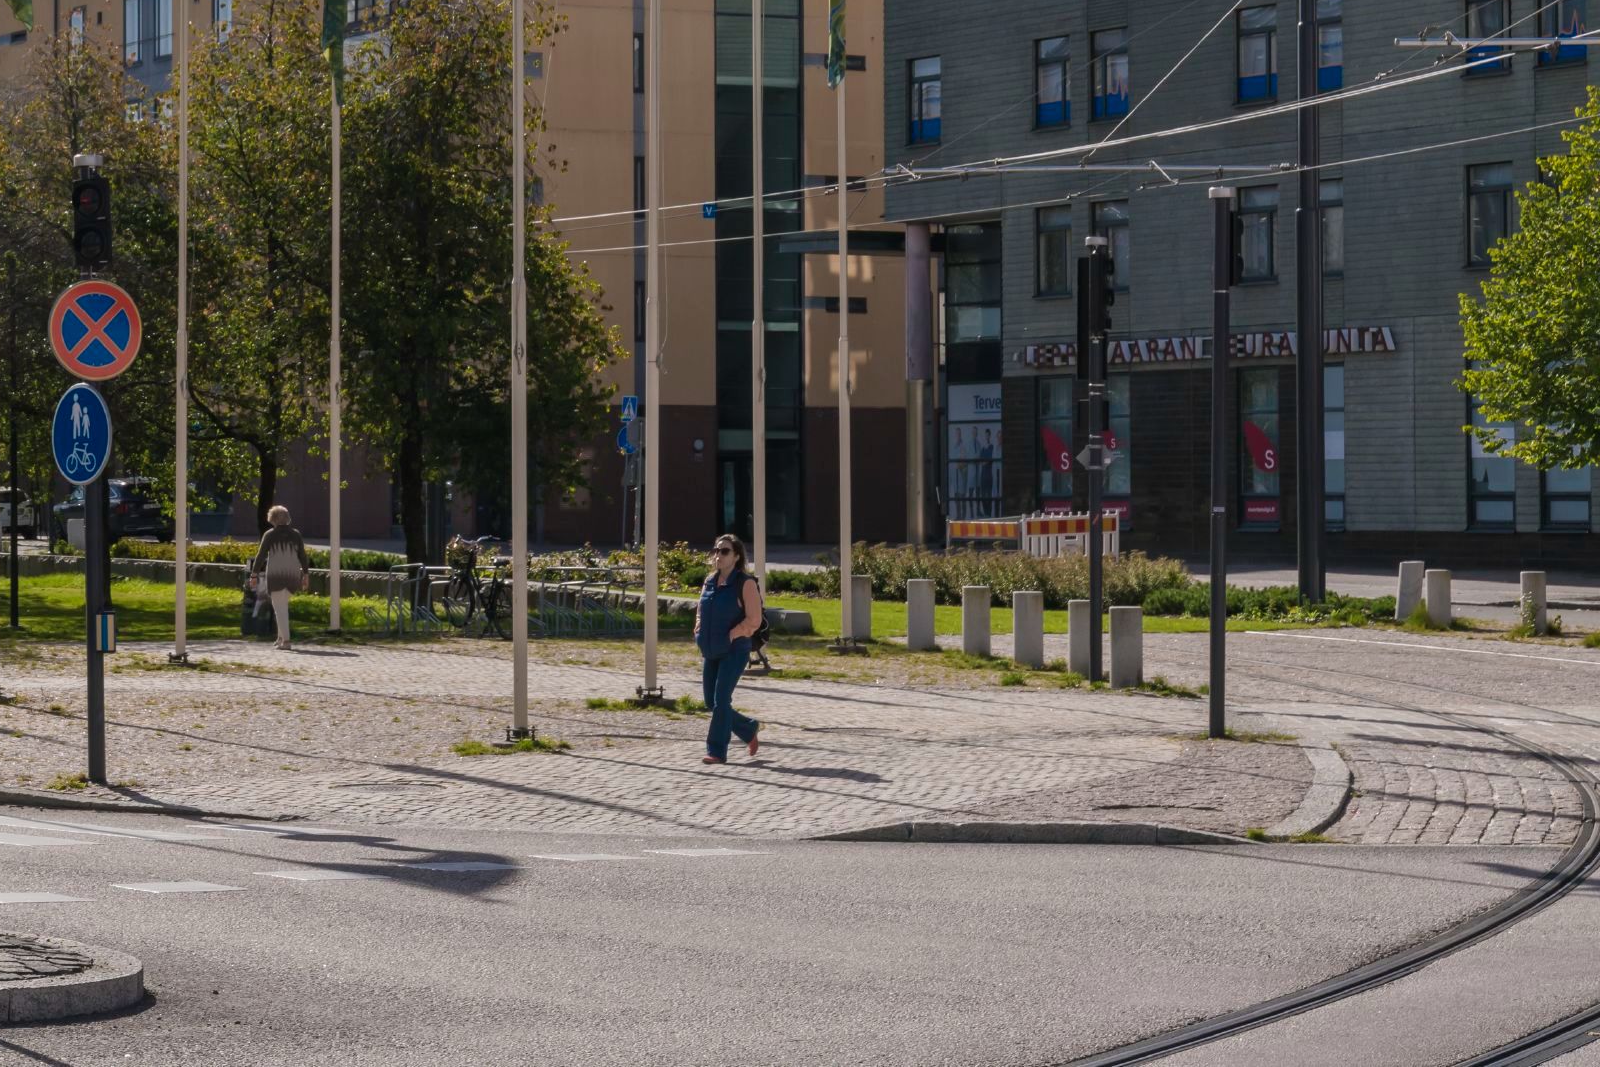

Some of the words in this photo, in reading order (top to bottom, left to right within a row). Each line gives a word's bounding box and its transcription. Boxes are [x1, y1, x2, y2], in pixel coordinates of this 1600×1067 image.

[1024, 336, 1202, 368] LEPPAARAN
[973, 395, 1001, 410] Terve
[1061, 452, 1070, 470] S
[1264, 449, 1275, 469] S
